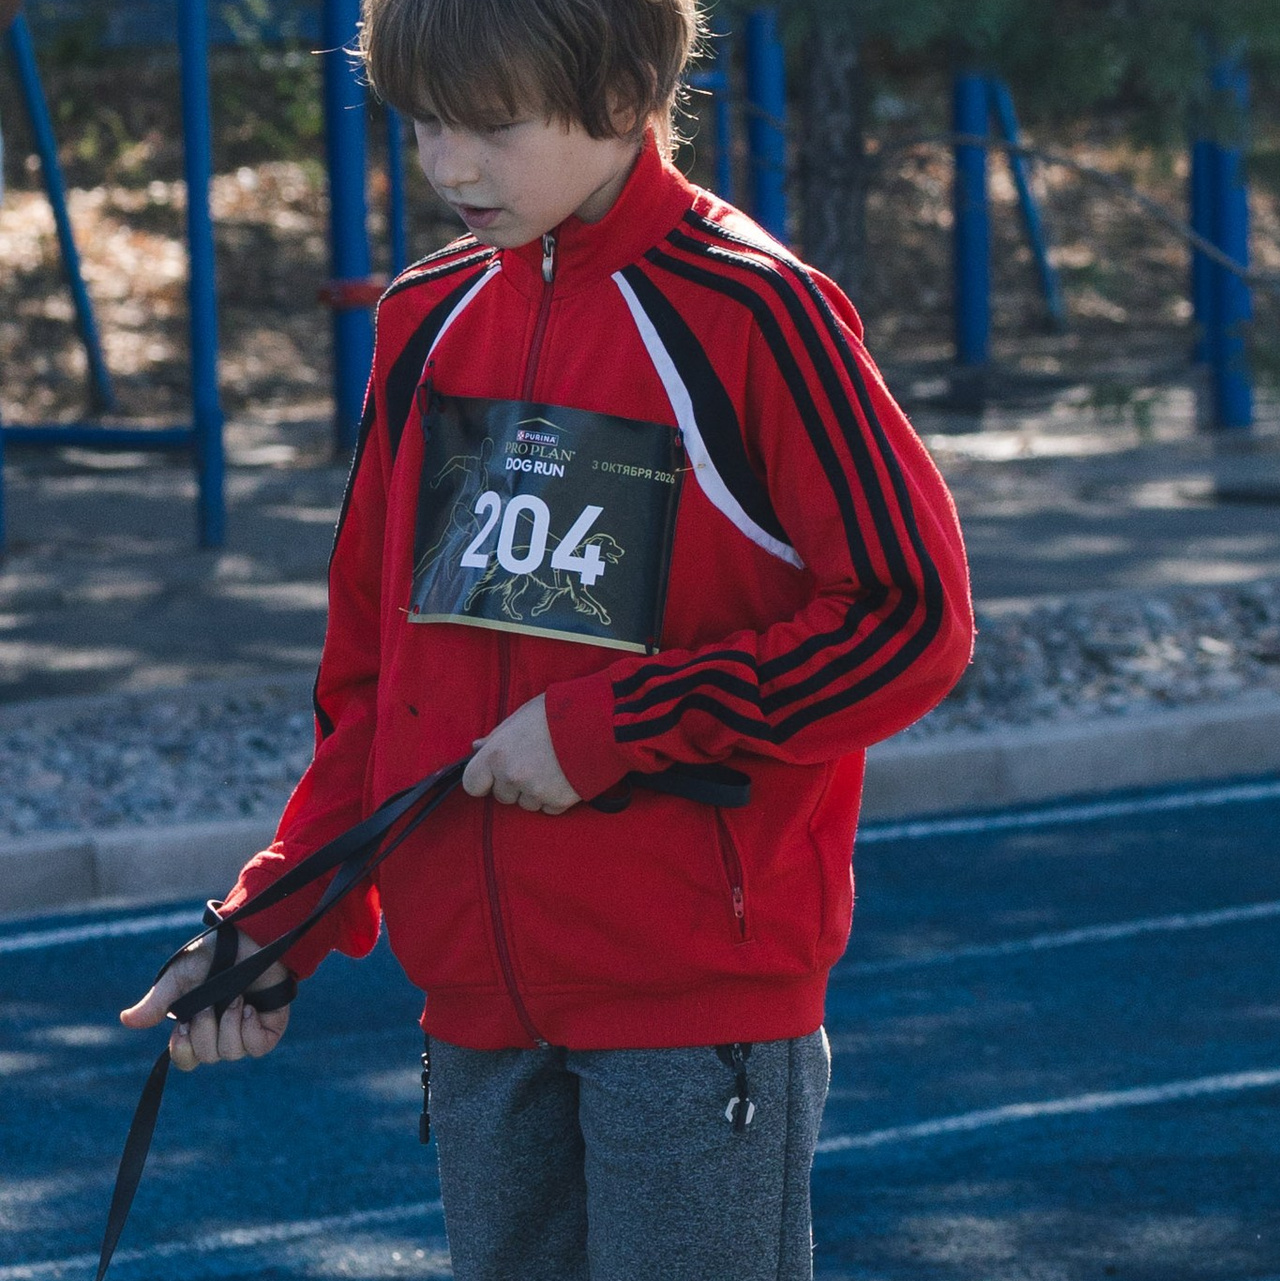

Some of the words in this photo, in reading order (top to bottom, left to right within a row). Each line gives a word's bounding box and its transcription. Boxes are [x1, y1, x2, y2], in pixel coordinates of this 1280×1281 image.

[525, 432, 556, 444] PURINA
[504, 441, 528, 455] PRO
[530, 444, 574, 462] PLAN
[505, 457, 533, 472] DOG
[533, 461, 565, 478] RUN
[592, 460, 599, 470] 3
[601, 461, 653, 480] ОКТЯБРЯ
[654, 471, 676, 484] 2026
[460, 490, 606, 586] 204
